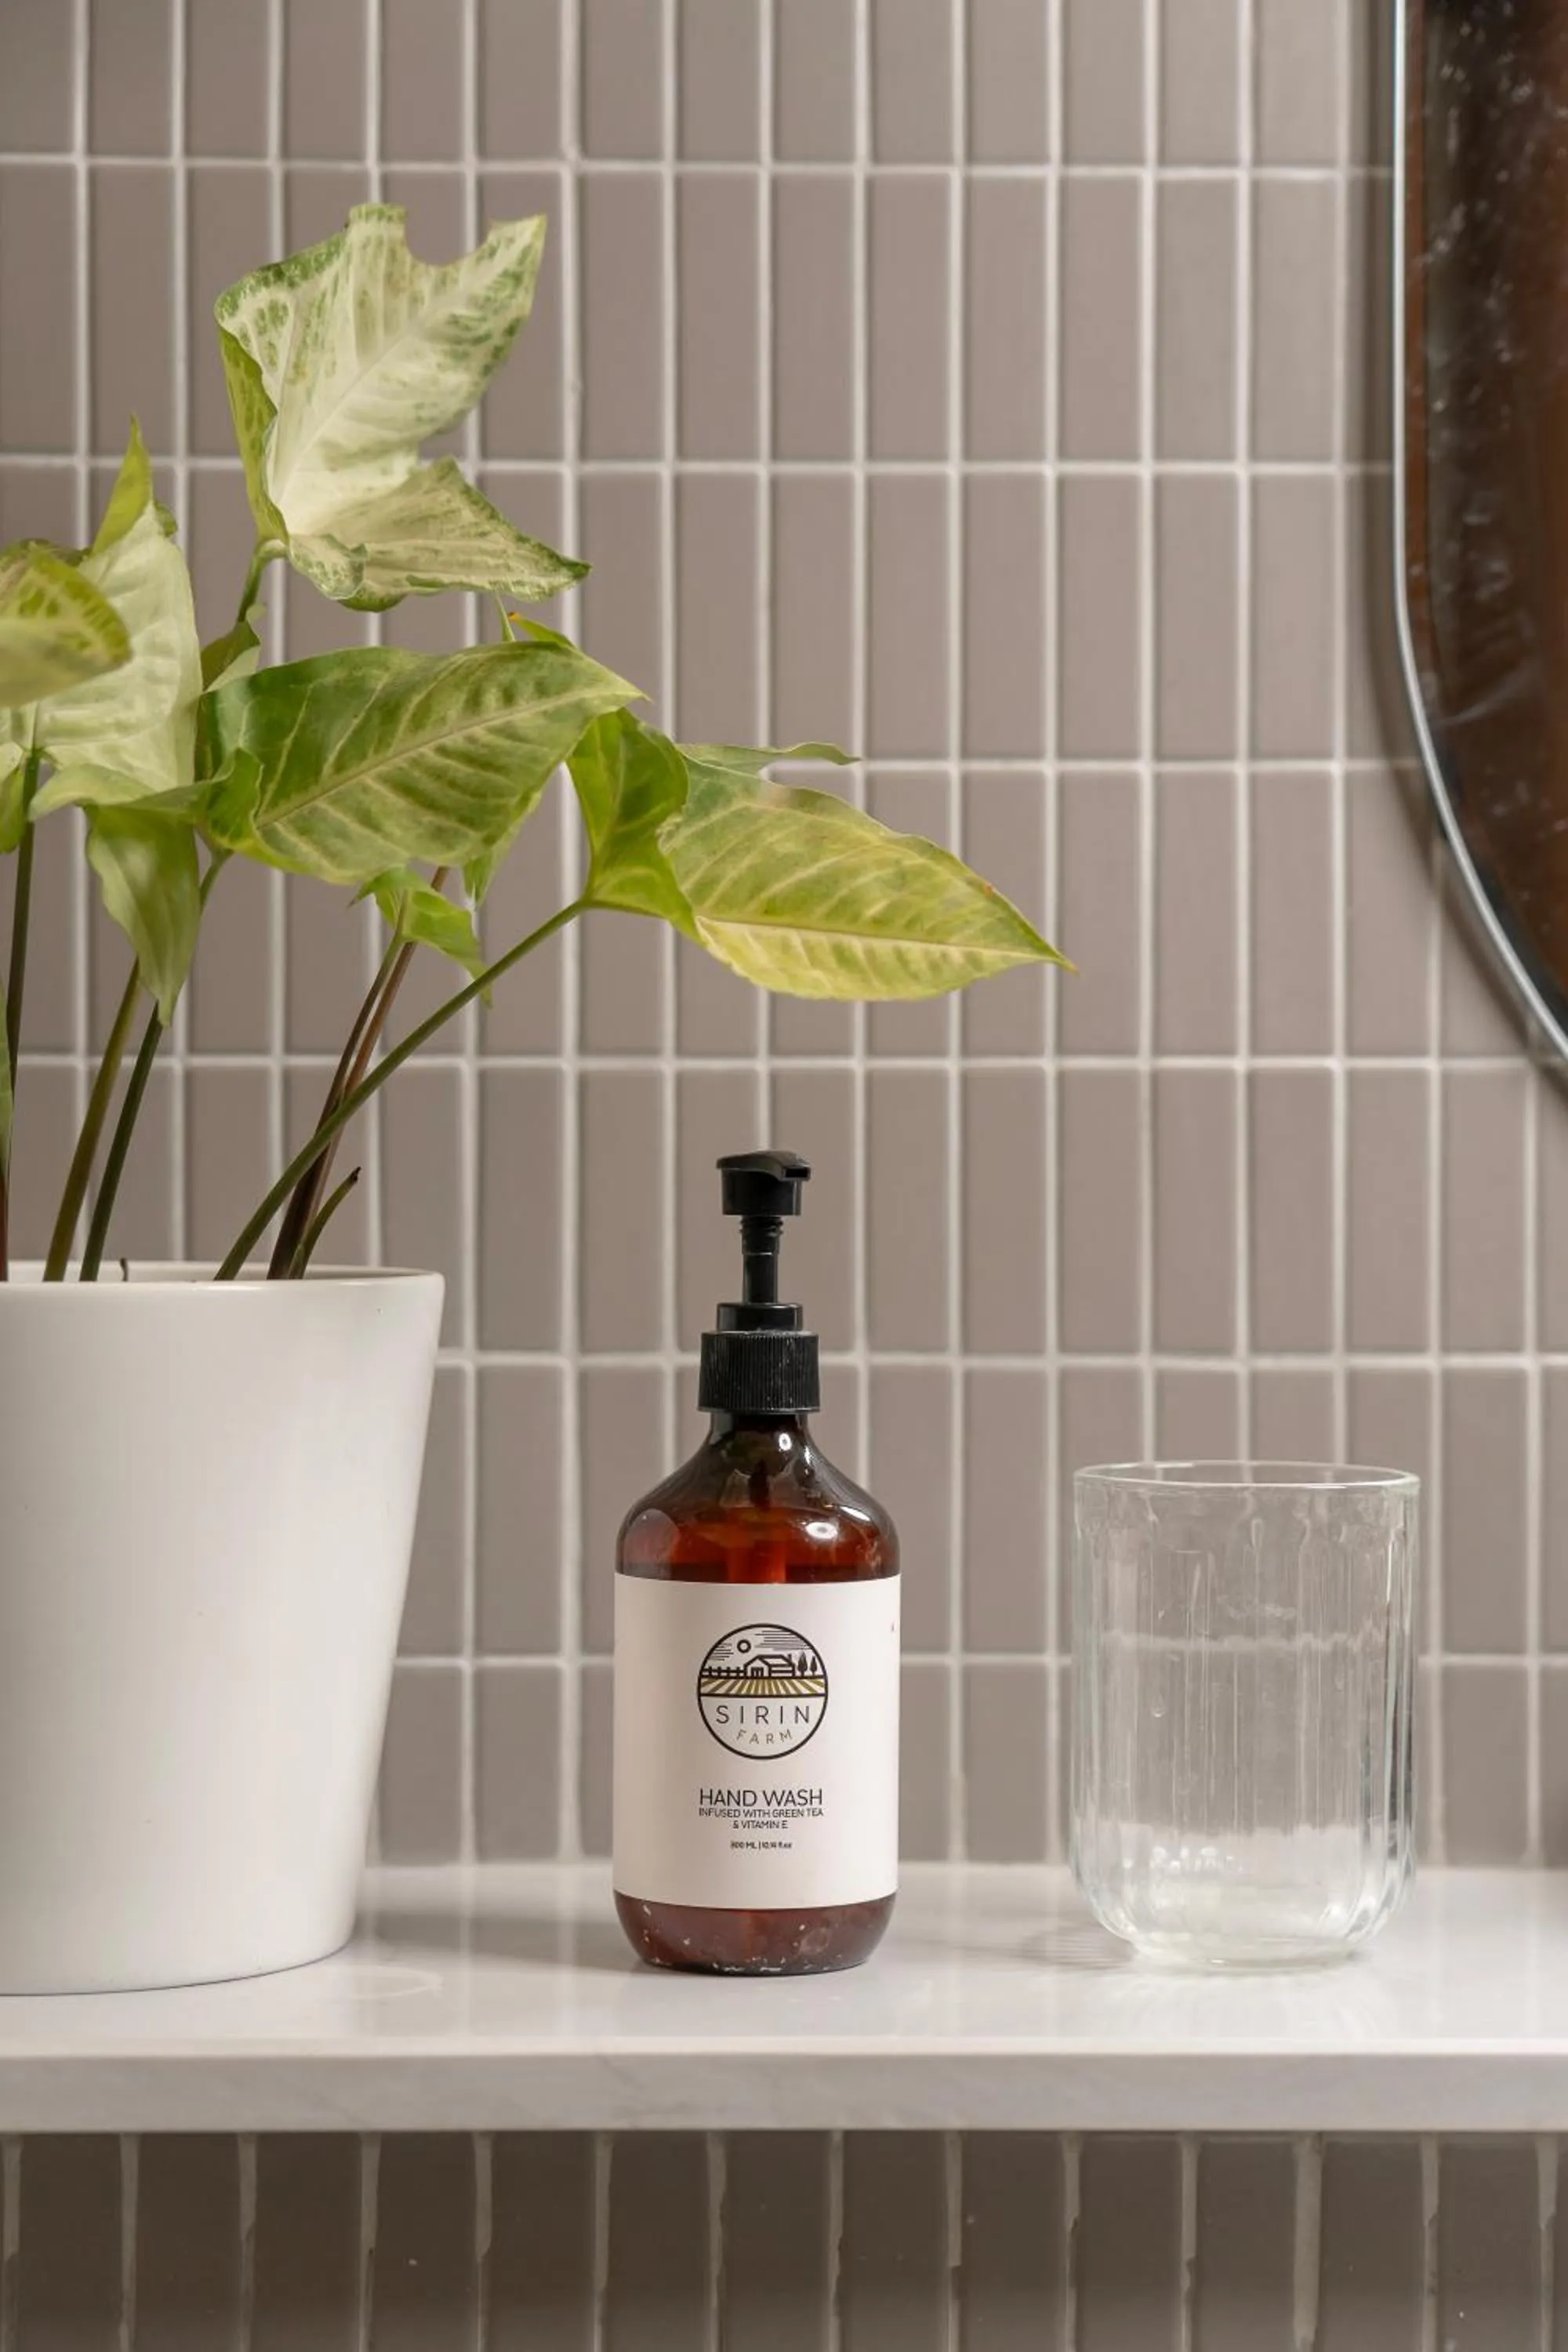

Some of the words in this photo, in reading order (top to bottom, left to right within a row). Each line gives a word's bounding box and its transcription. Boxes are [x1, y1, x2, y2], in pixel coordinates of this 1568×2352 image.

[716, 1705, 810, 1724] SIRIN
[736, 1729, 793, 1744] FARM
[700, 1788, 757, 1806] HAND
[763, 1788, 822, 1806] WASH
[699, 1807, 741, 1818] INFUSED
[743, 1809, 771, 1818] WITH
[772, 1808, 804, 1817] GREEN
[807, 1807, 824, 1817] TEA
[732, 1820, 739, 1829] &
[741, 1820, 779, 1829] VITAMIN
[781, 1820, 789, 1829] E
